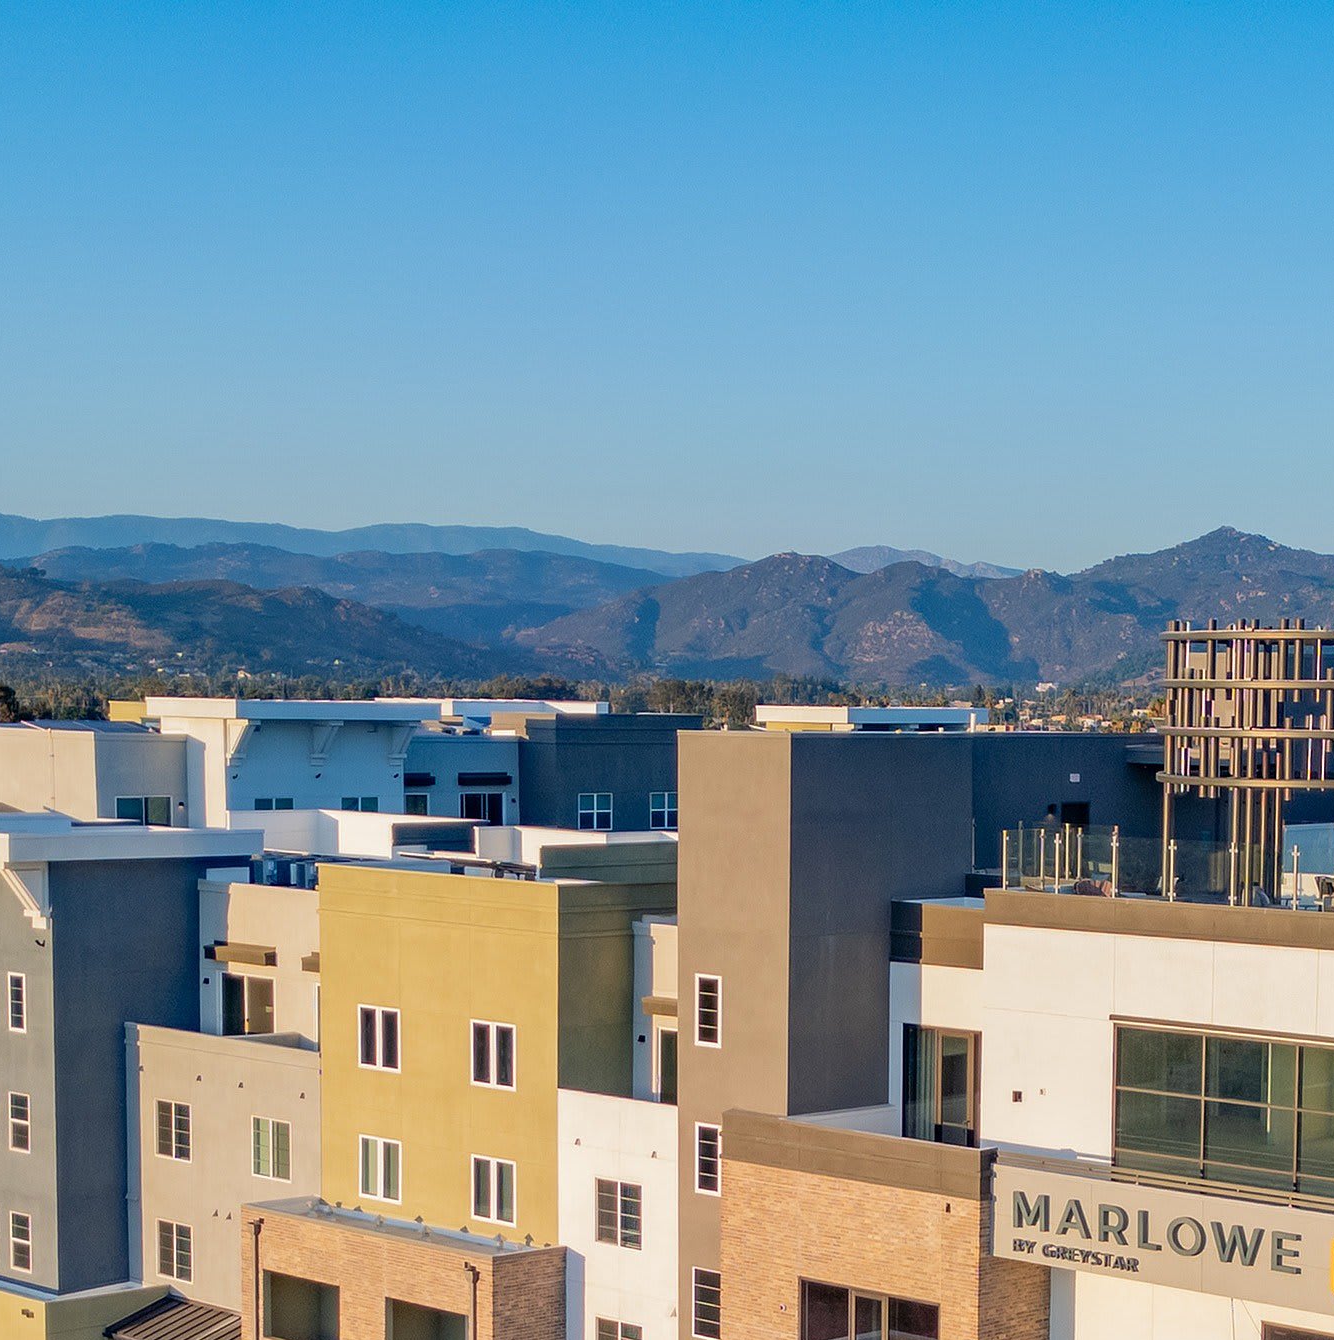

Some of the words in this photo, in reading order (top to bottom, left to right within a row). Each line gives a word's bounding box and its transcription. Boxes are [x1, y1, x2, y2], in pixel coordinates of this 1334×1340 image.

[1012, 1190, 1302, 1275] MARLOWE
[1013, 1238, 1037, 1253] BY
[1042, 1244, 1139, 1272] GREYSTAR
